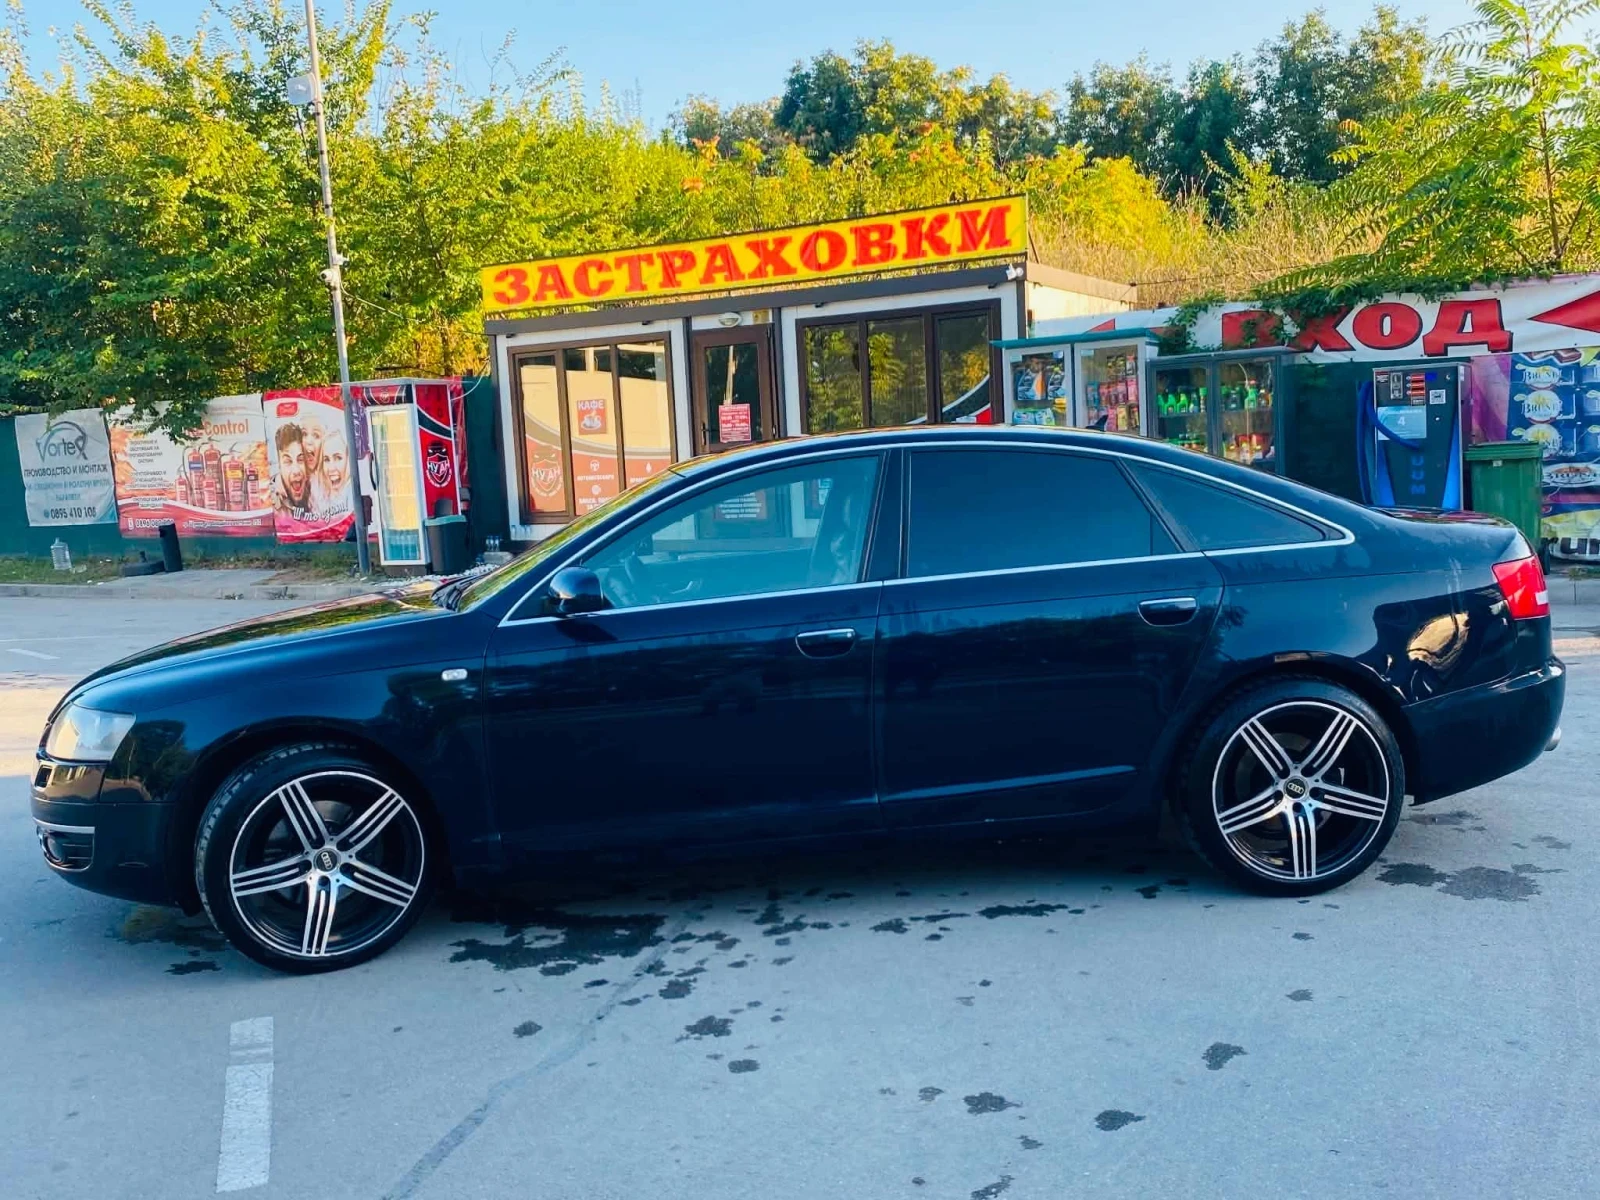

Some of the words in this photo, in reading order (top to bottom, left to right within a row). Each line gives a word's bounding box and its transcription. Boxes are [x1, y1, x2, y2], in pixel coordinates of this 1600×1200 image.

[494, 205, 1011, 305] ЗАСТРАХОВКИ
[577, 399, 604, 411] КАФЕ
[73, 466, 78, 475] И
[78, 464, 108, 475] МОНТАЖ
